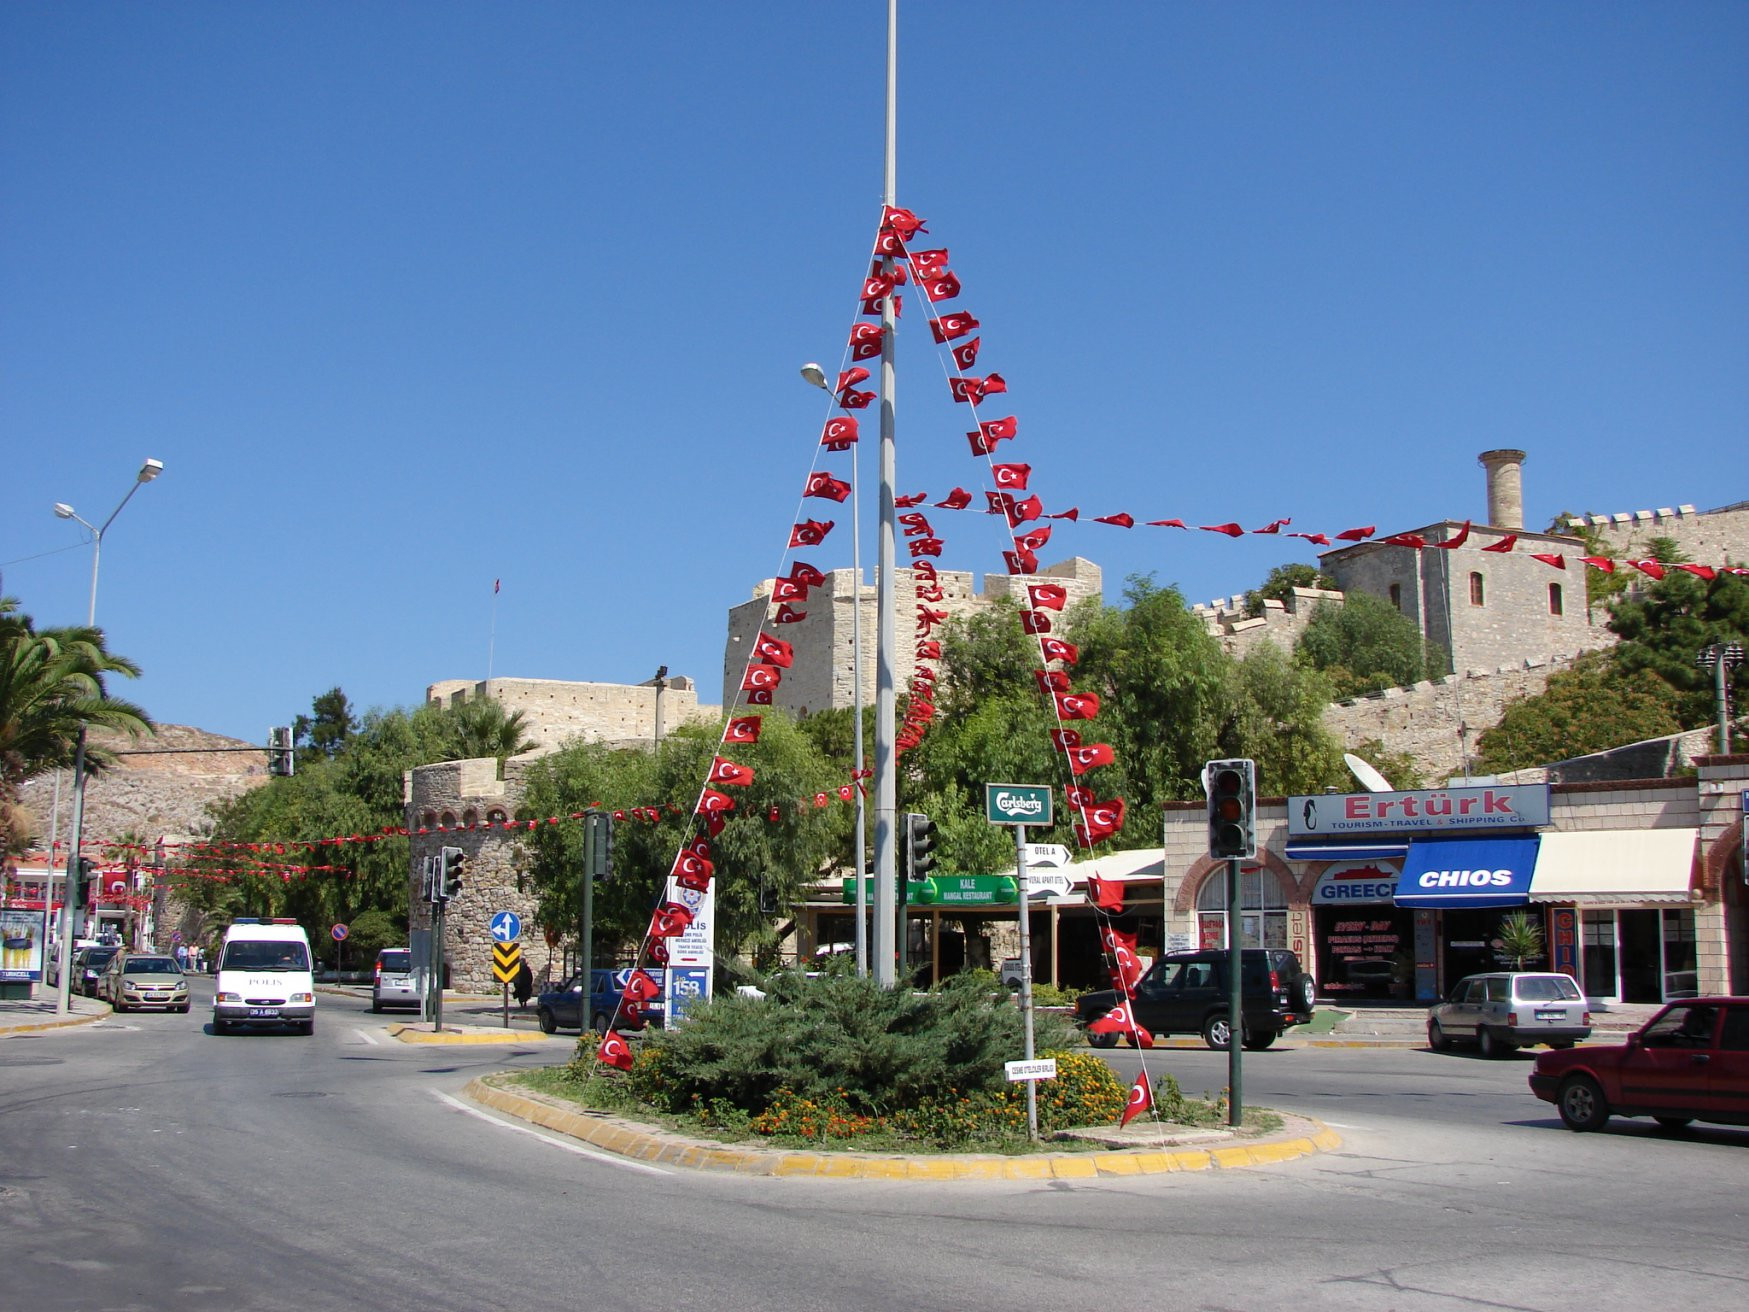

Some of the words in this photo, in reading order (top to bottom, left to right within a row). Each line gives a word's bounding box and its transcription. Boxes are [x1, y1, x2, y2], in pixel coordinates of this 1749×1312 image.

[996, 791, 1042, 815] Carlsberg
[1344, 790, 1514, 820] Ertürk
[1449, 816, 1505, 825] SHIPPING
[1034, 846, 1049, 855] OTEL
[1051, 847, 1056, 855] A
[959, 878, 976, 890] KALE
[1418, 869, 1513, 888] CHIOS
[963, 891, 993, 900] RESTAURANT
[683, 921, 707, 931] OLİS
[1557, 912, 1575, 977] CHIO
